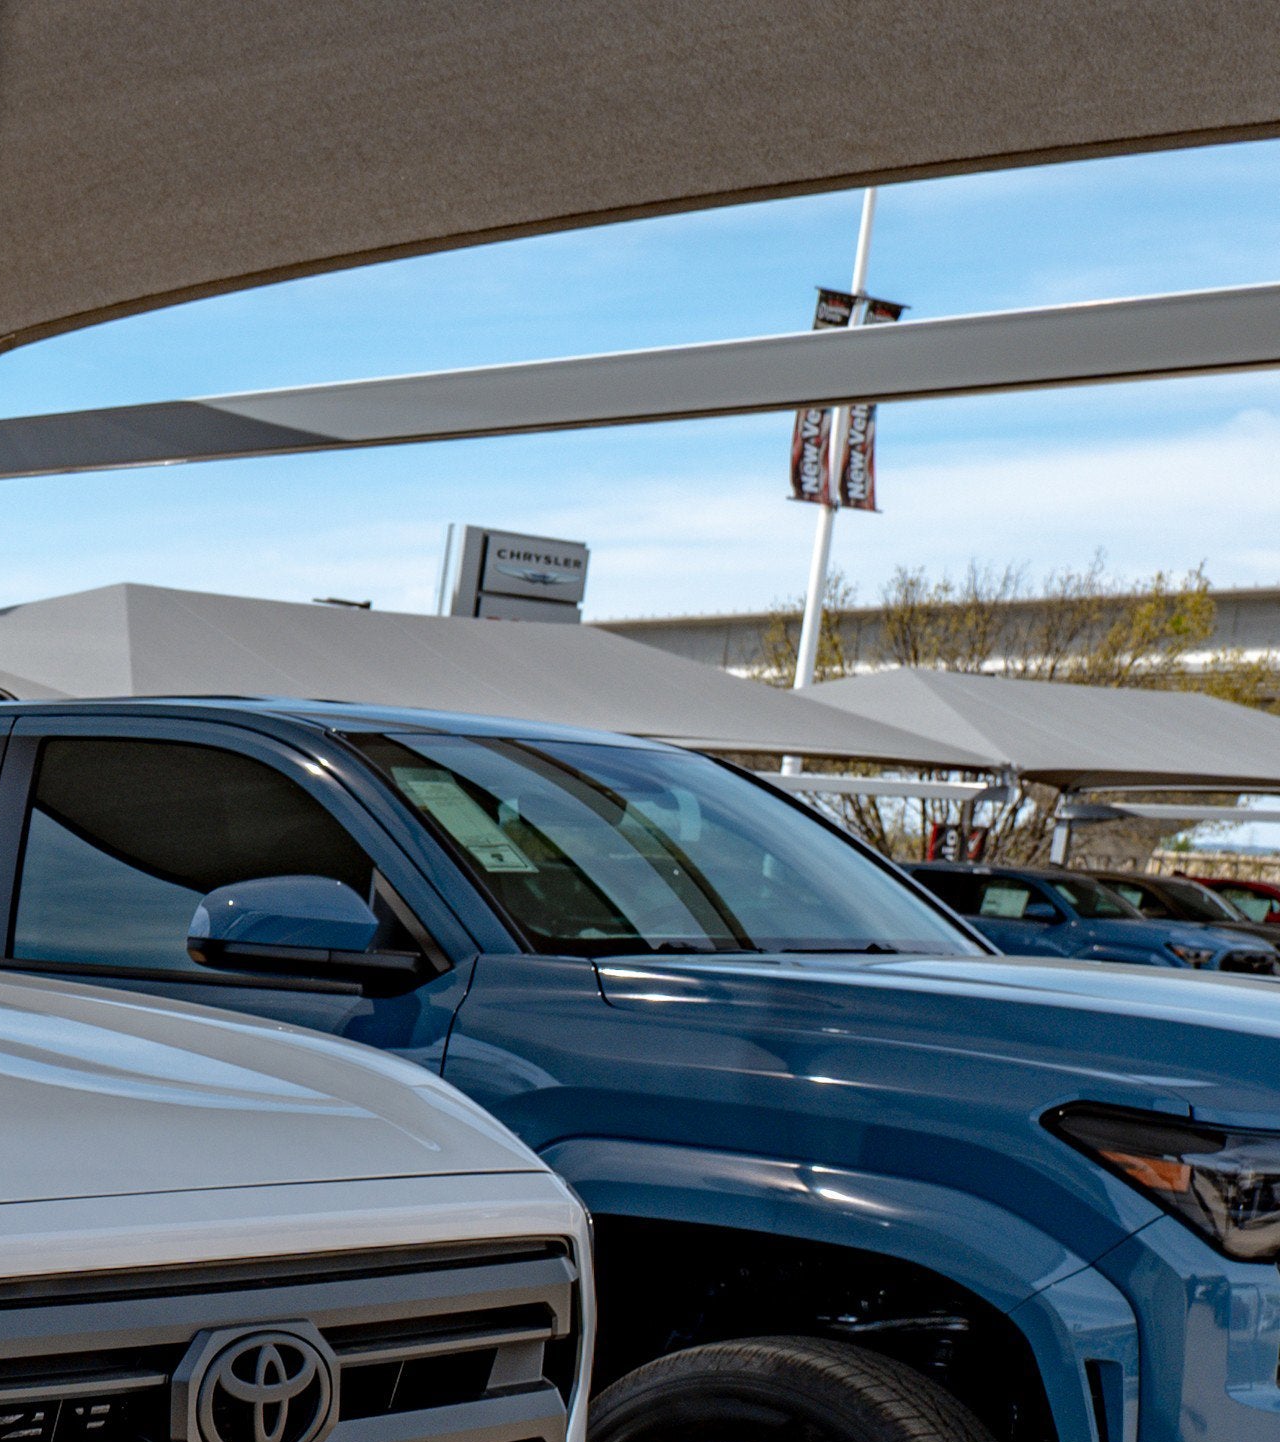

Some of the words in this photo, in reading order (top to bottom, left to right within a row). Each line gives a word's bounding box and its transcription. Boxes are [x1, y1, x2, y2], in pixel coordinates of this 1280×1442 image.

[800, 443, 820, 494] New
[847, 449, 867, 499] New
[497, 548, 582, 569] CHRYSLER
